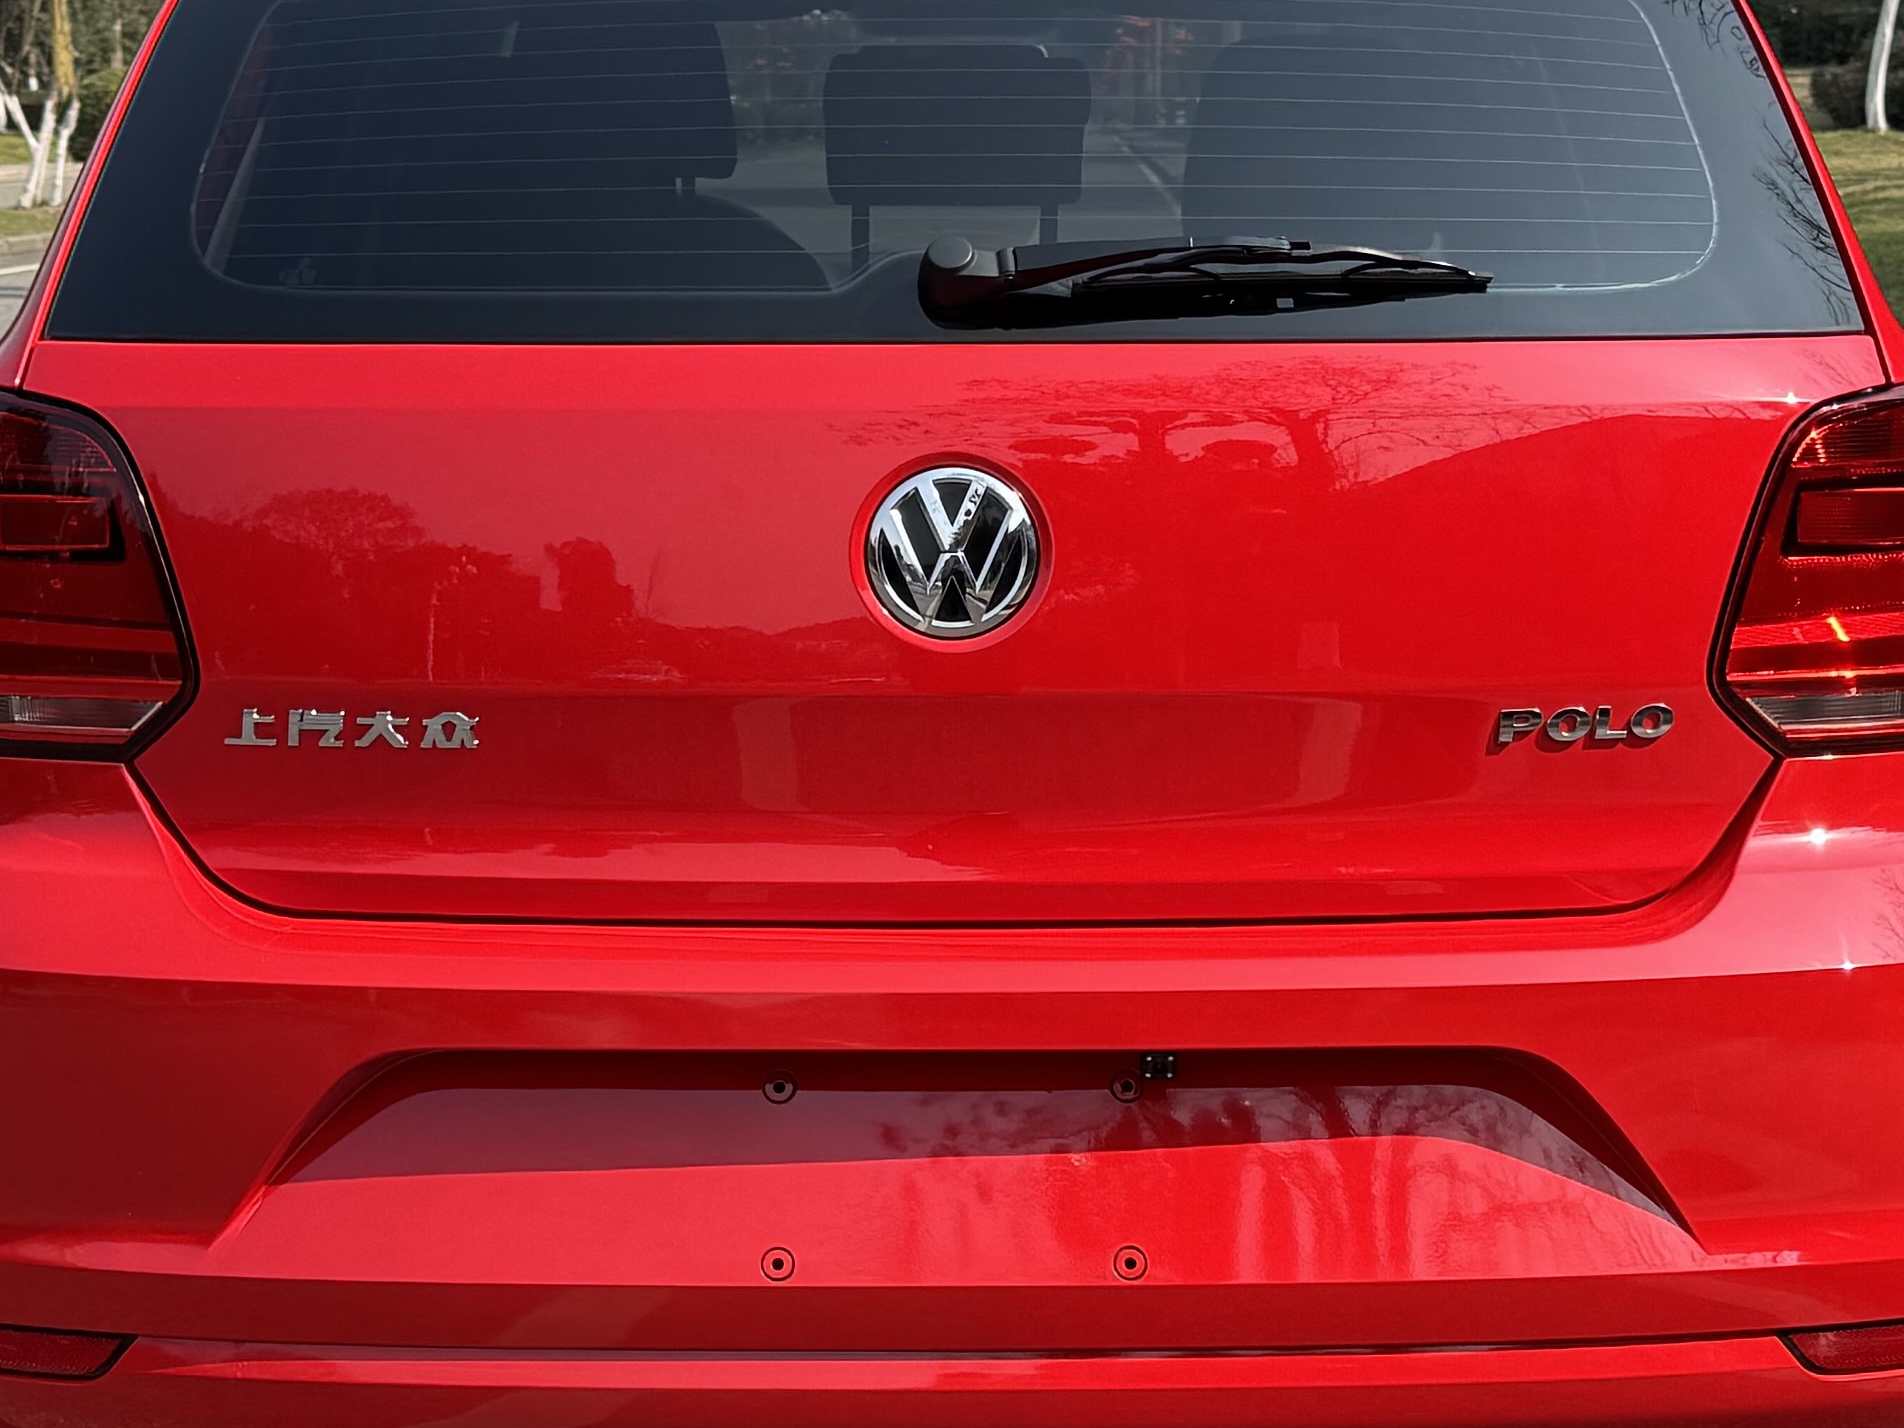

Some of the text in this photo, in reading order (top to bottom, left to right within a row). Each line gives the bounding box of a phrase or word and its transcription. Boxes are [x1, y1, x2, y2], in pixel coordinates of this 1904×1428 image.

[865, 467, 1039, 638] VW
[223, 708, 479, 749] 上汽大众
[1498, 702, 1674, 743] POLO
